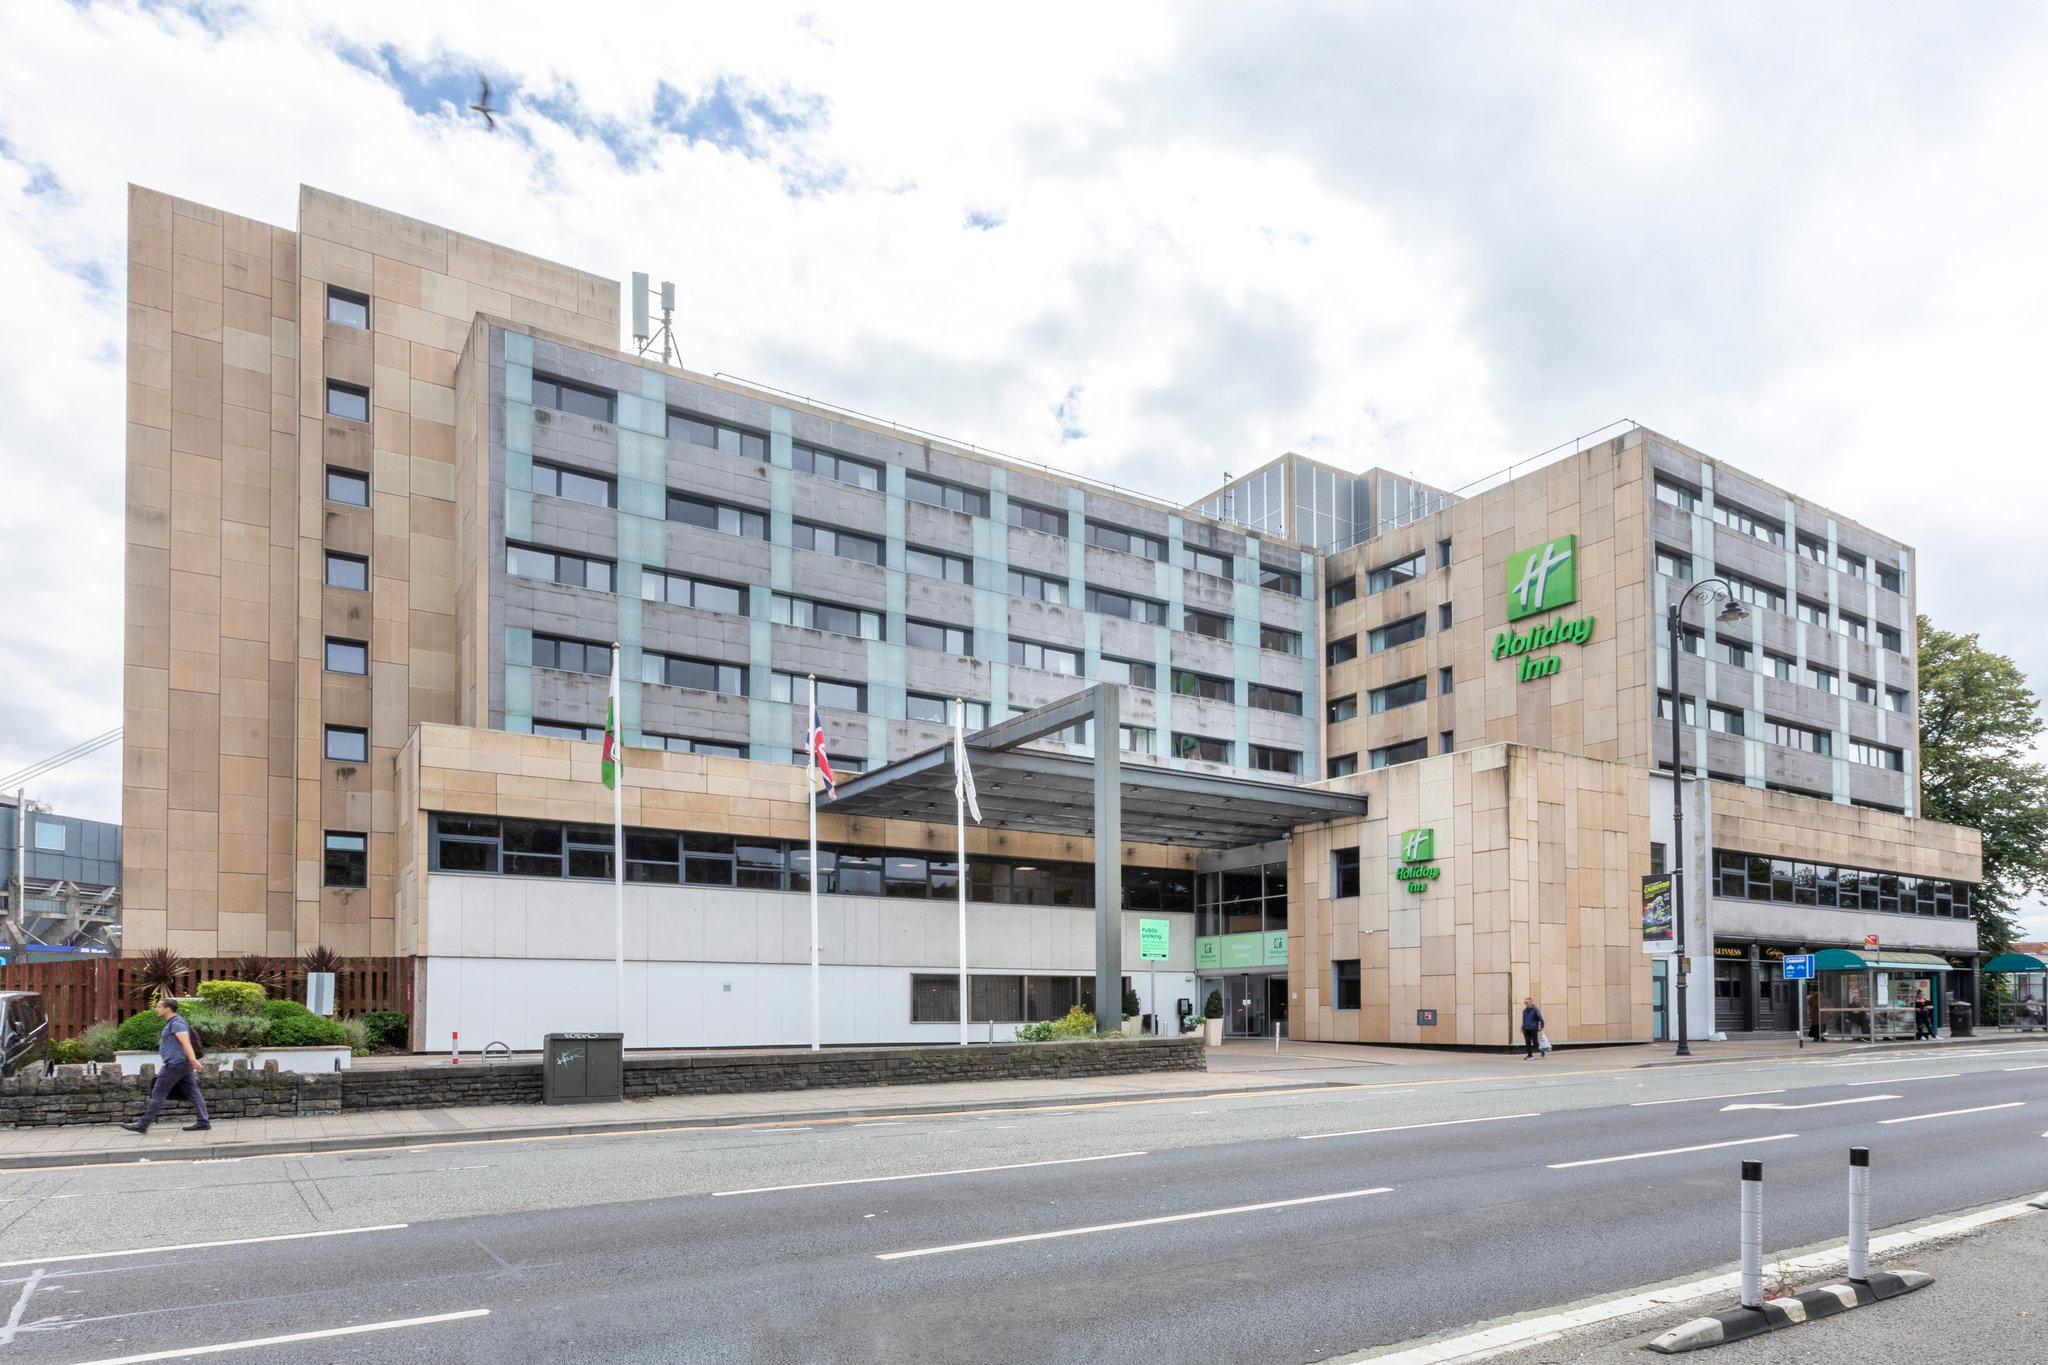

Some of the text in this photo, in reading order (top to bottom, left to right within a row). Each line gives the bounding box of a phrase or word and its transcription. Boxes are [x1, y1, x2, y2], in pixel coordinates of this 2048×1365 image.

[1491, 615, 1595, 661] Holiday
[1518, 655, 1562, 682] Inn
[1396, 864, 1441, 881] Holiday
[1407, 881, 1428, 893] Inn
[1714, 947, 1742, 957] GUINNESS
